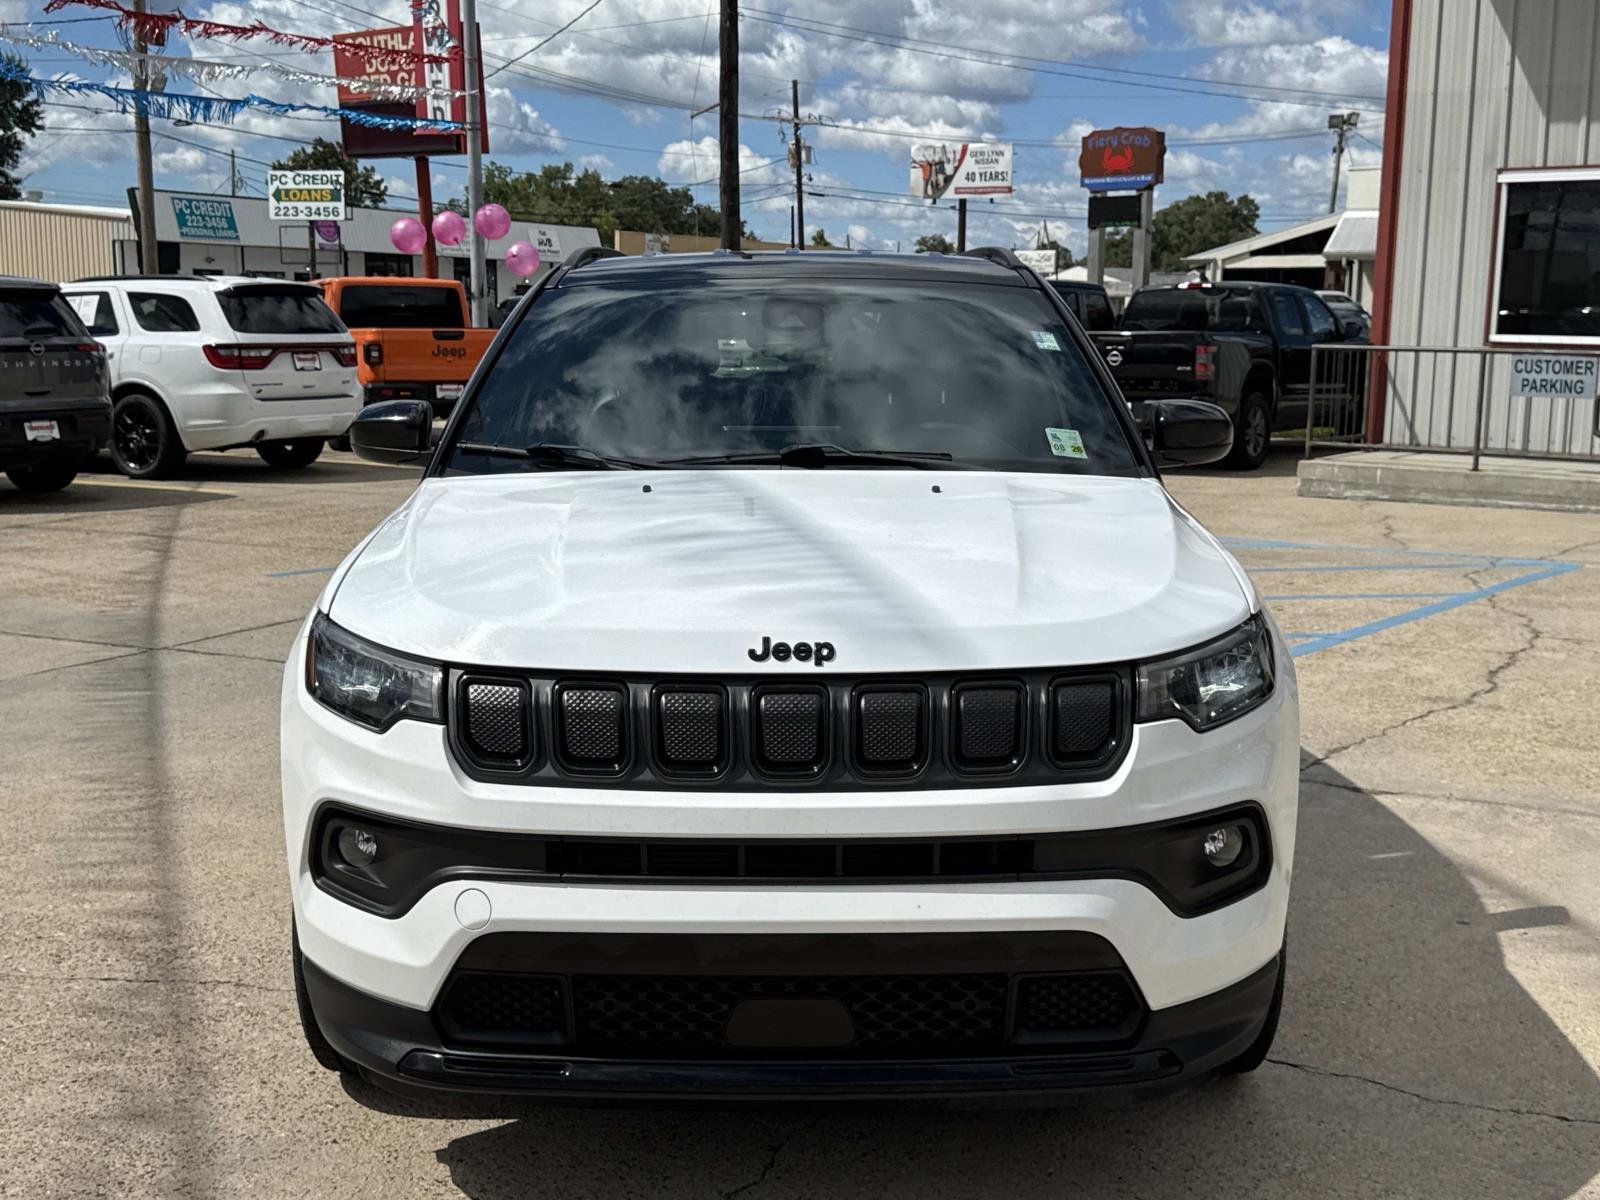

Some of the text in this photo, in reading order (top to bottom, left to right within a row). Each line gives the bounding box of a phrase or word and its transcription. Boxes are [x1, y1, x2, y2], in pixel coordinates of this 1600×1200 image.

[1120, 132, 1151, 146] Crab
[270, 174, 343, 186] PC CREDIT
[965, 171, 1009, 182] 40 YEARS!
[281, 189, 332, 201] LOANS
[174, 199, 232, 217] PC CREDIT
[274, 206, 340, 218] 223-3456
[186, 215, 228, 228] 223-3456
[431, 345, 467, 358] Jeep
[1514, 359, 1594, 376] CUSTOMER
[1521, 378, 1585, 395] PARKING
[748, 636, 837, 667] Jeep
